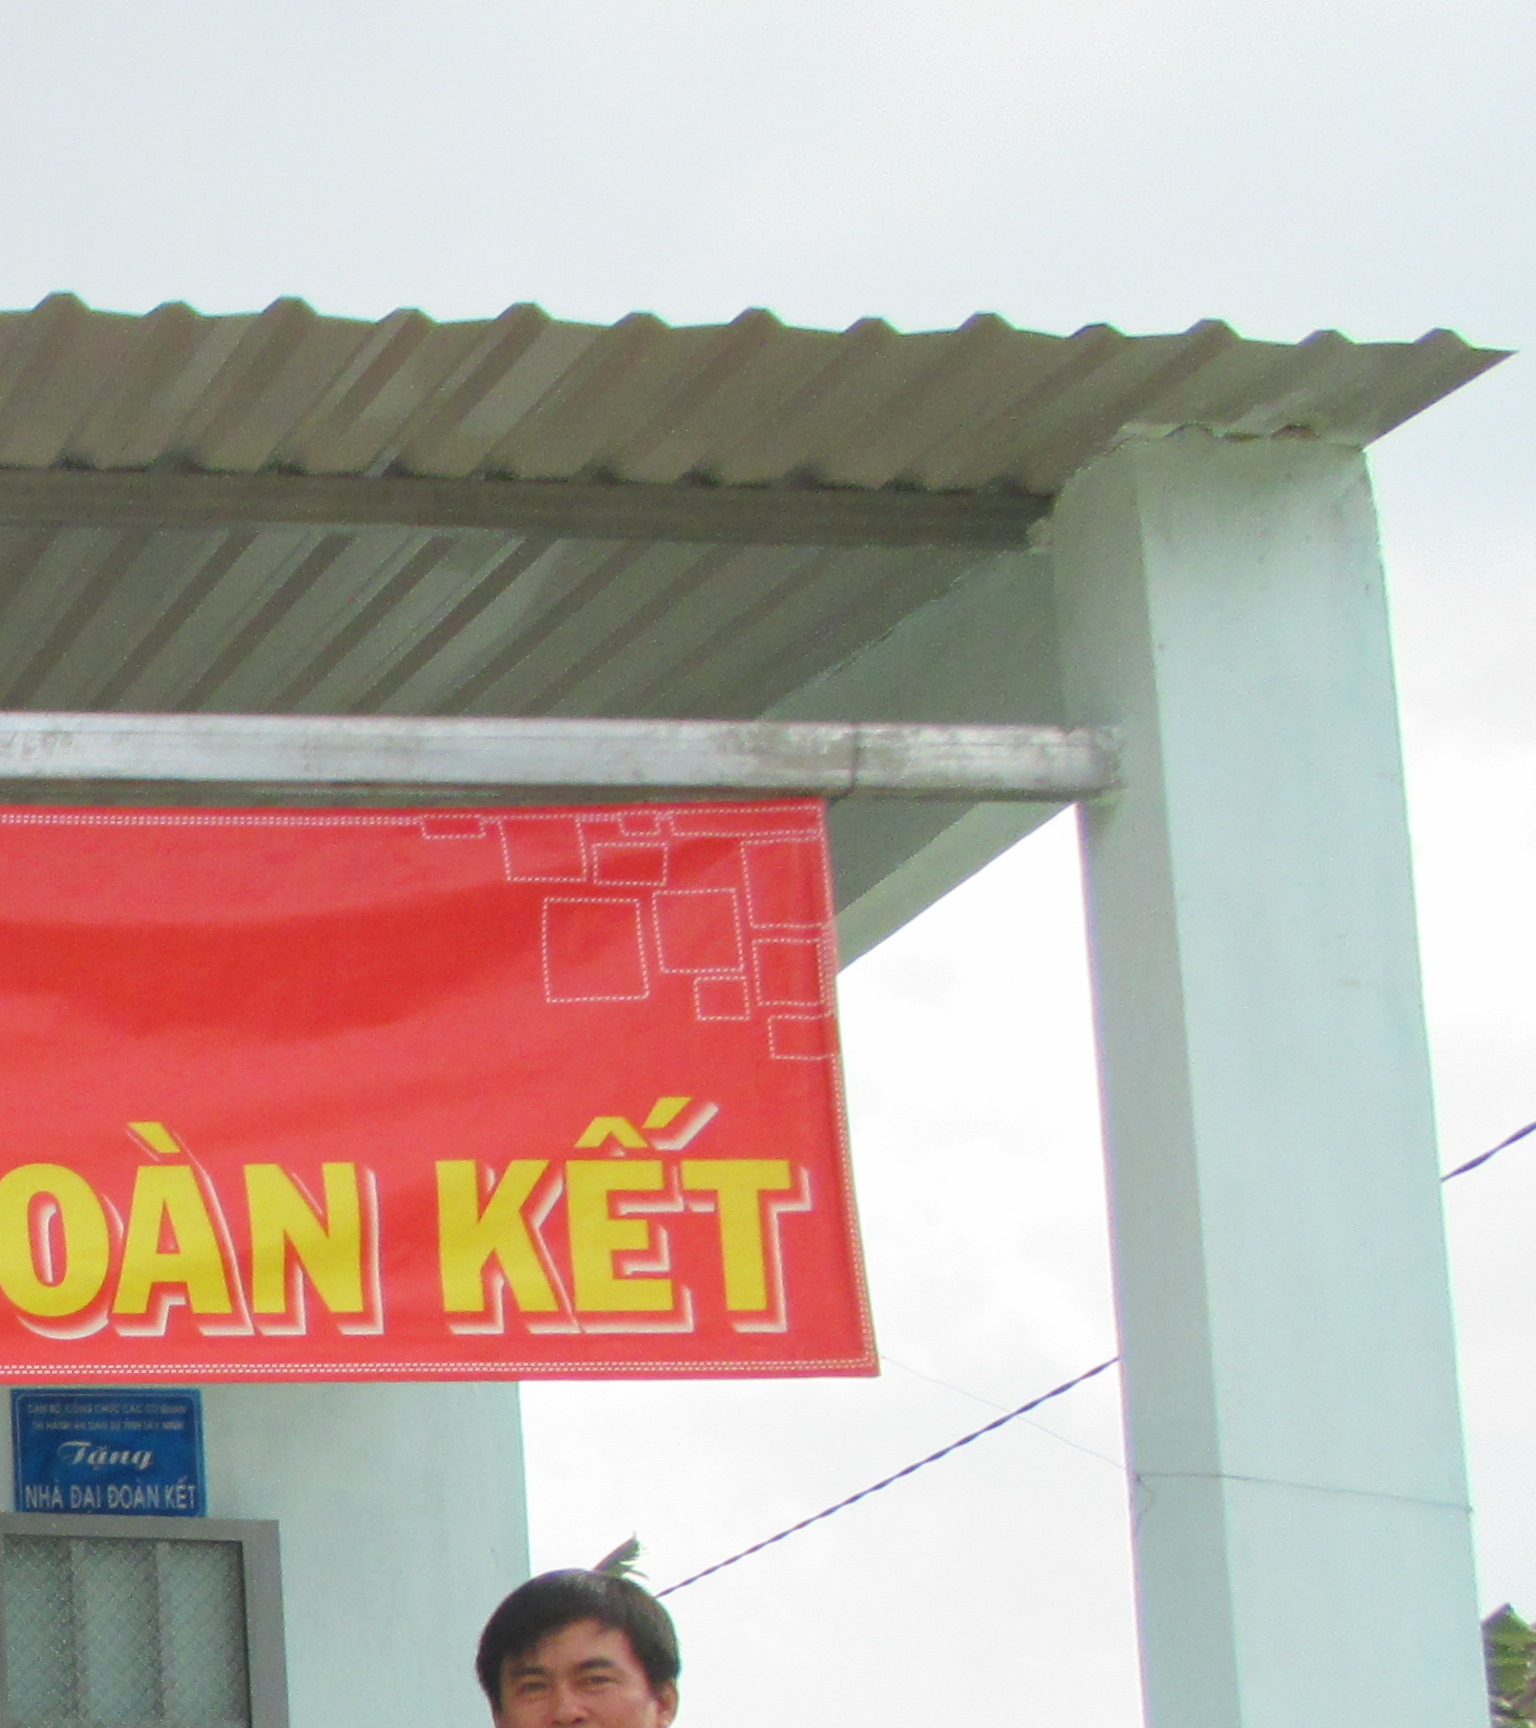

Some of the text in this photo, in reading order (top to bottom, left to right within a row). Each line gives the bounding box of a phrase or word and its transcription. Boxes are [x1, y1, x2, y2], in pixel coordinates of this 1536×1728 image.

[438, 1099, 798, 1320] KẾT
[56, 1440, 154, 1471] Tặng
[25, 1478, 64, 1509] NHÀ
[107, 1477, 160, 1509] ĐOÀN
[165, 1475, 196, 1509] KẾT
